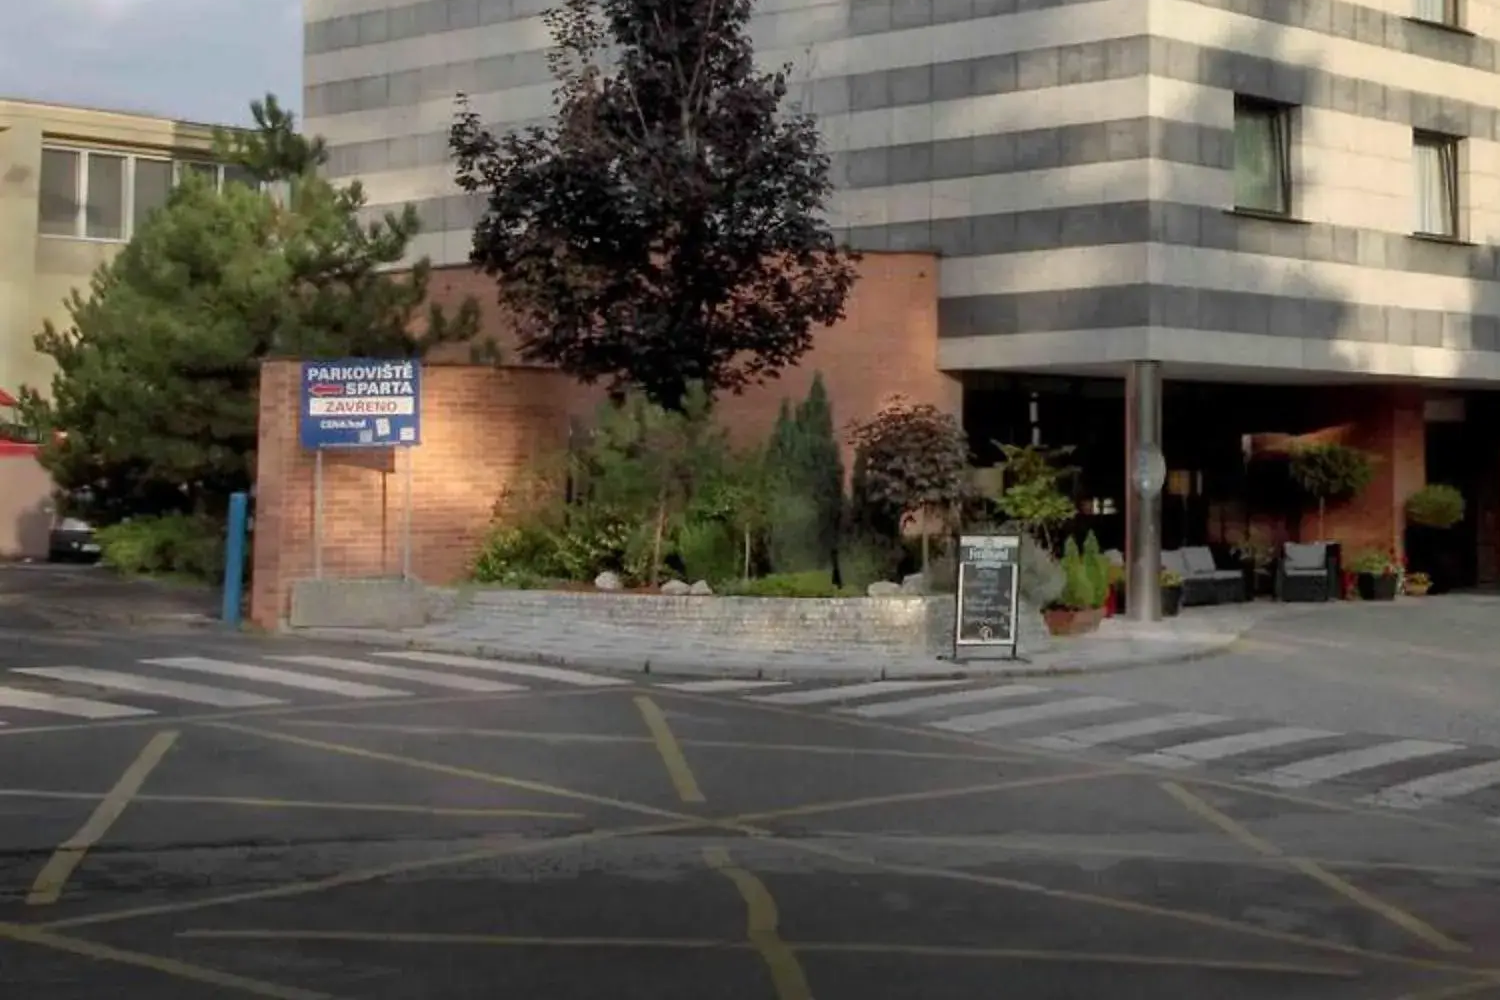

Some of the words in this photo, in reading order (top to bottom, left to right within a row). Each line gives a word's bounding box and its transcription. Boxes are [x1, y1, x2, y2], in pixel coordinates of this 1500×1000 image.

[307, 360, 414, 381] PARKOVIŠTĚ
[345, 381, 414, 395] SPARTA
[325, 400, 398, 412] ZAVŘENO
